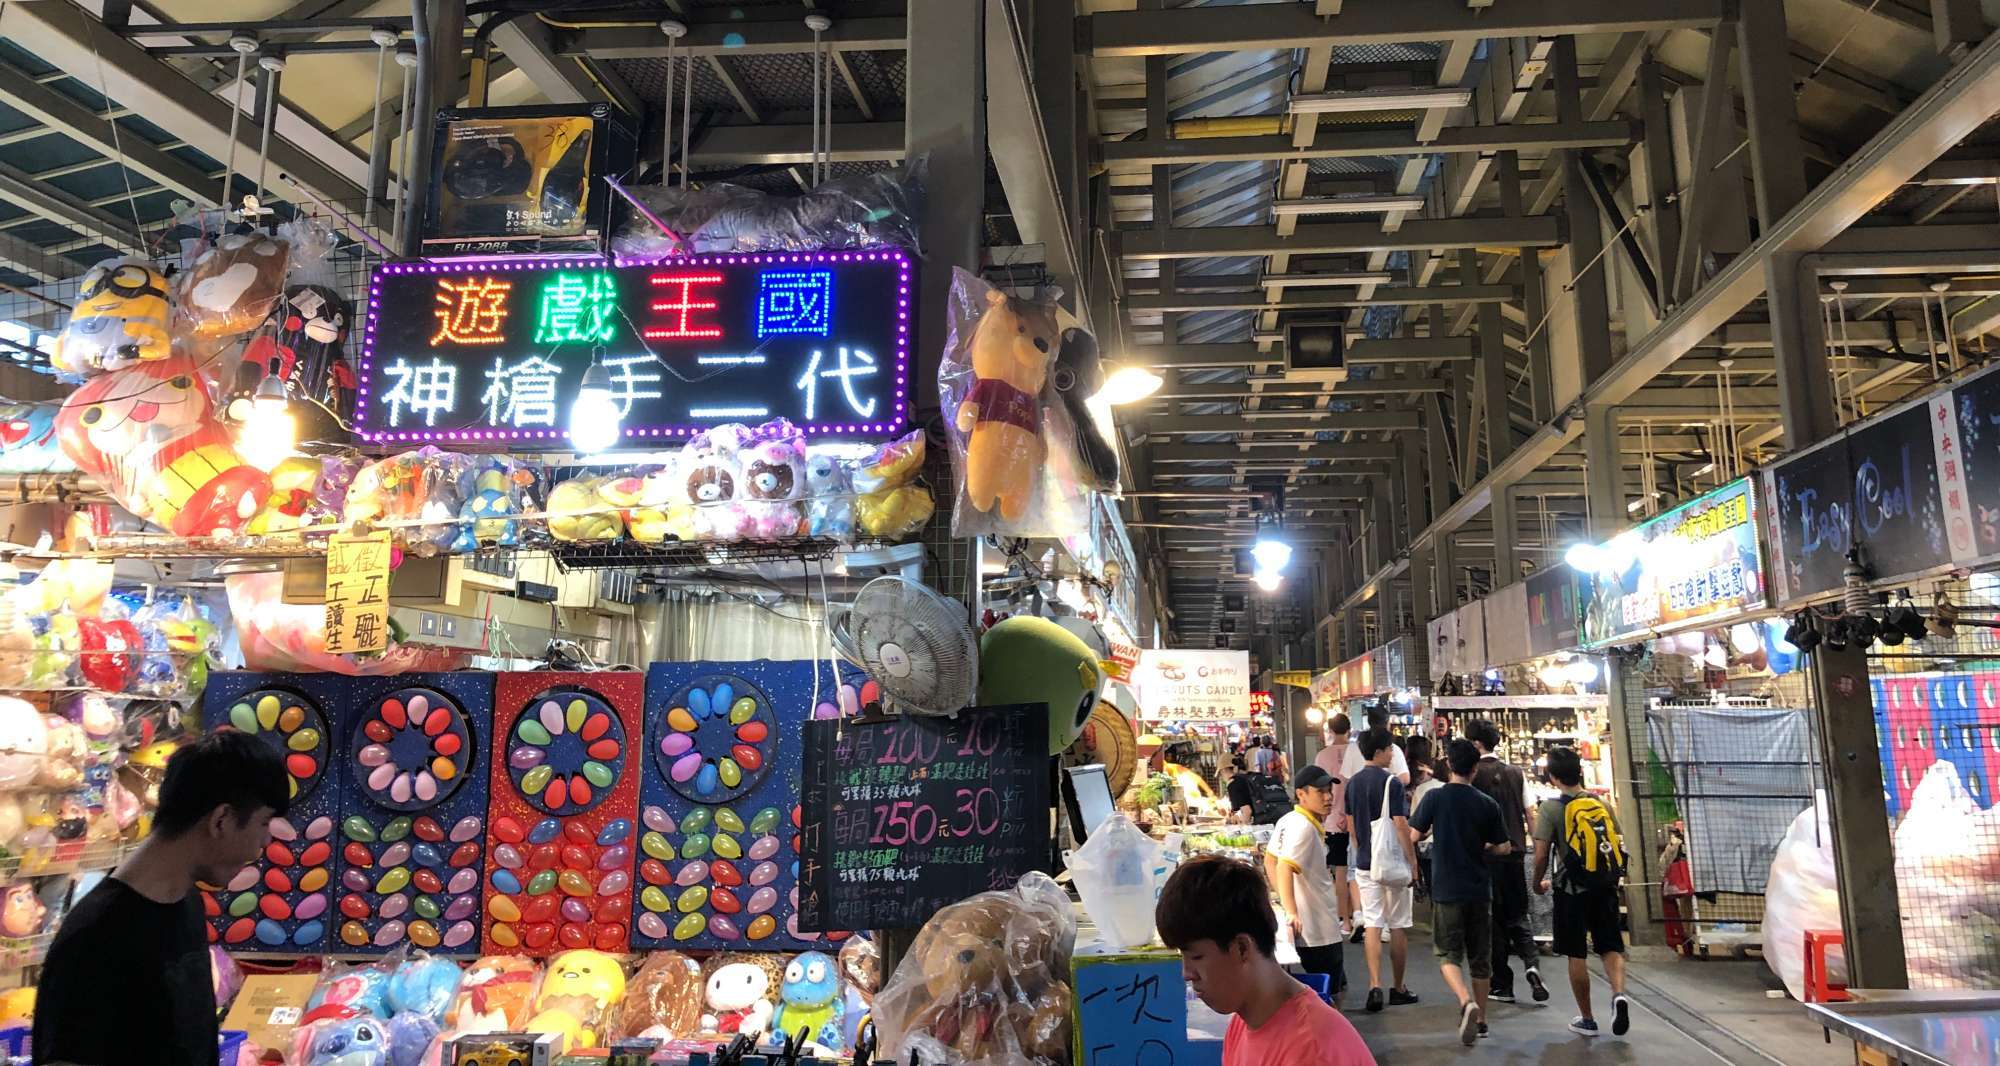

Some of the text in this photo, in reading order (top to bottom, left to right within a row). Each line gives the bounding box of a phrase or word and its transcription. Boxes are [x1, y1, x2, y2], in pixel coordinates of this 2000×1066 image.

[522, 209, 552, 220] Sound
[430, 270, 830, 346] 遊戲王國
[380, 347, 878, 428] 神槍手二代
[1796, 442, 1916, 560] Easy Cool
[325, 581, 350, 651] 工讀生
[352, 574, 384, 649] 正職
[1206, 686, 1244, 696] CANDY
[1083, 974, 1173, 1024] 一次
